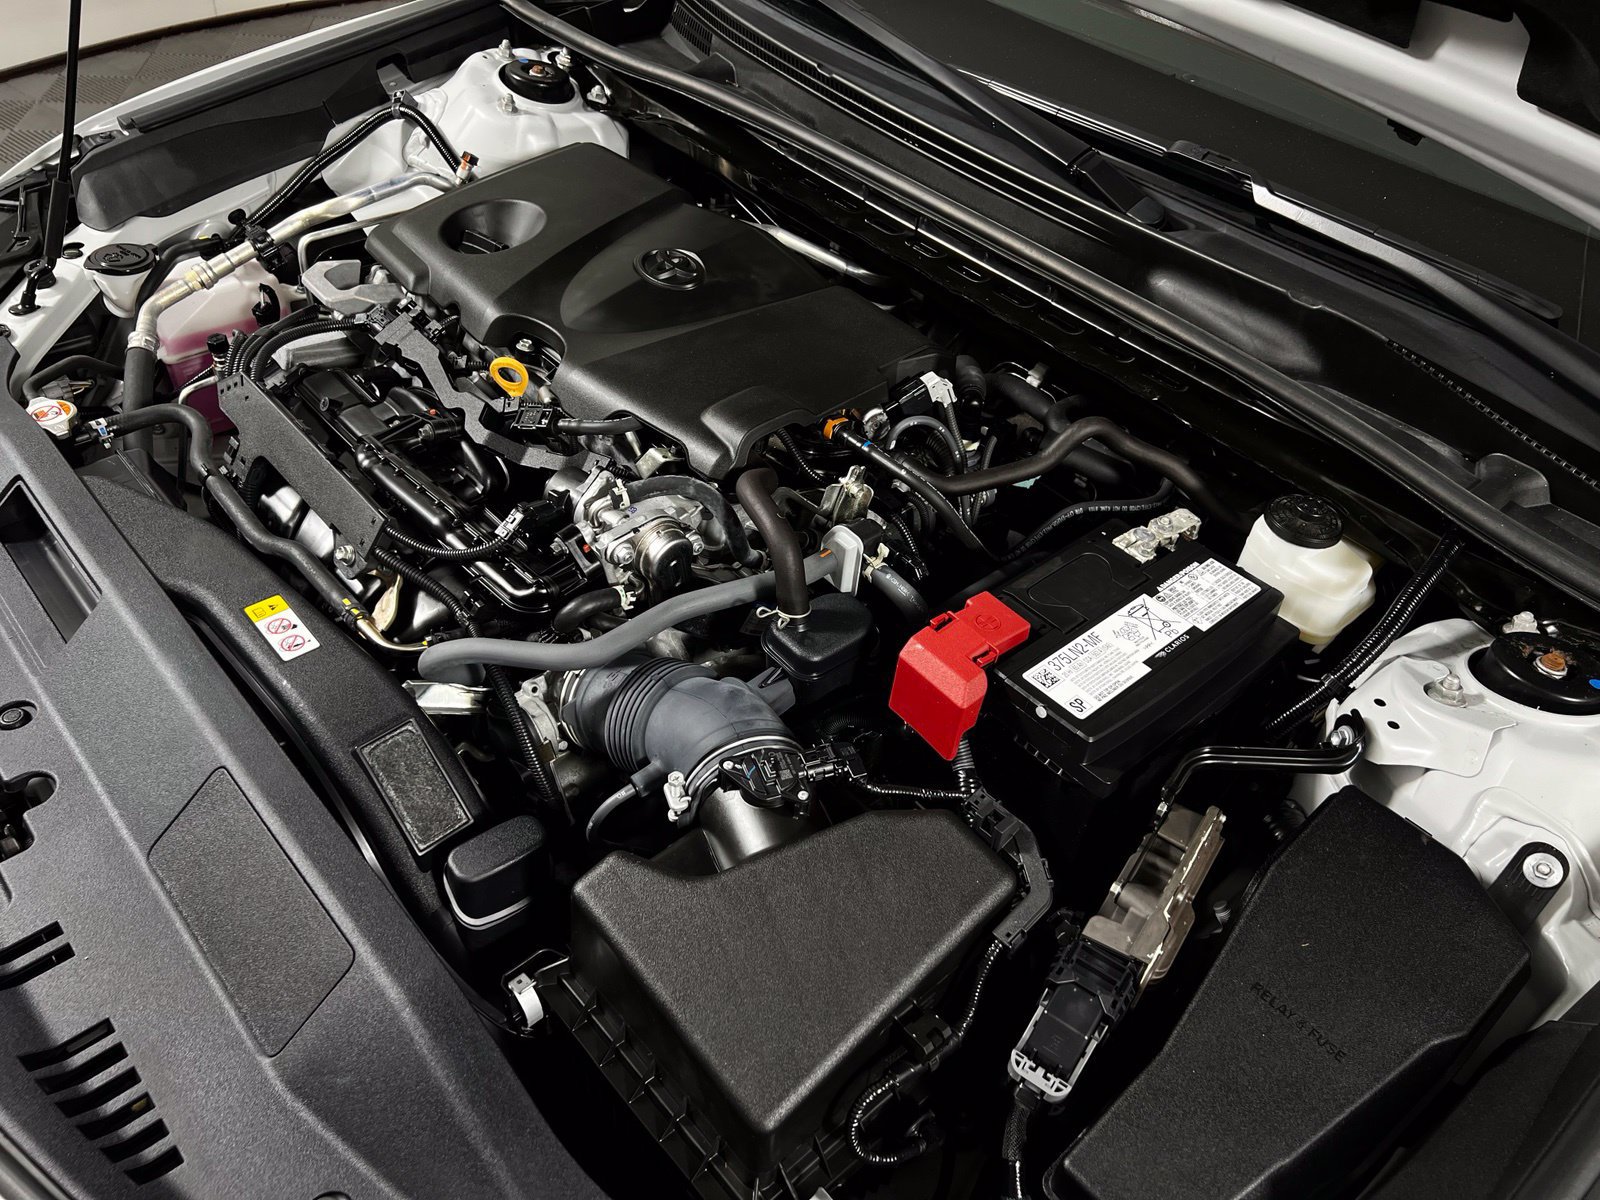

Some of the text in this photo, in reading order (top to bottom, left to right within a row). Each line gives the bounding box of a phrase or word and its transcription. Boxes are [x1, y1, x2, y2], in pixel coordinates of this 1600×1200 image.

[1164, 628, 1180, 639] Pb
[1164, 633, 1190, 653] CLARIOS
[1048, 631, 1103, 672] 375LN2-MF
[1069, 698, 1087, 713] SP
[1250, 982, 1297, 1019] RELAY
[1307, 1028, 1347, 1063] FUSE
